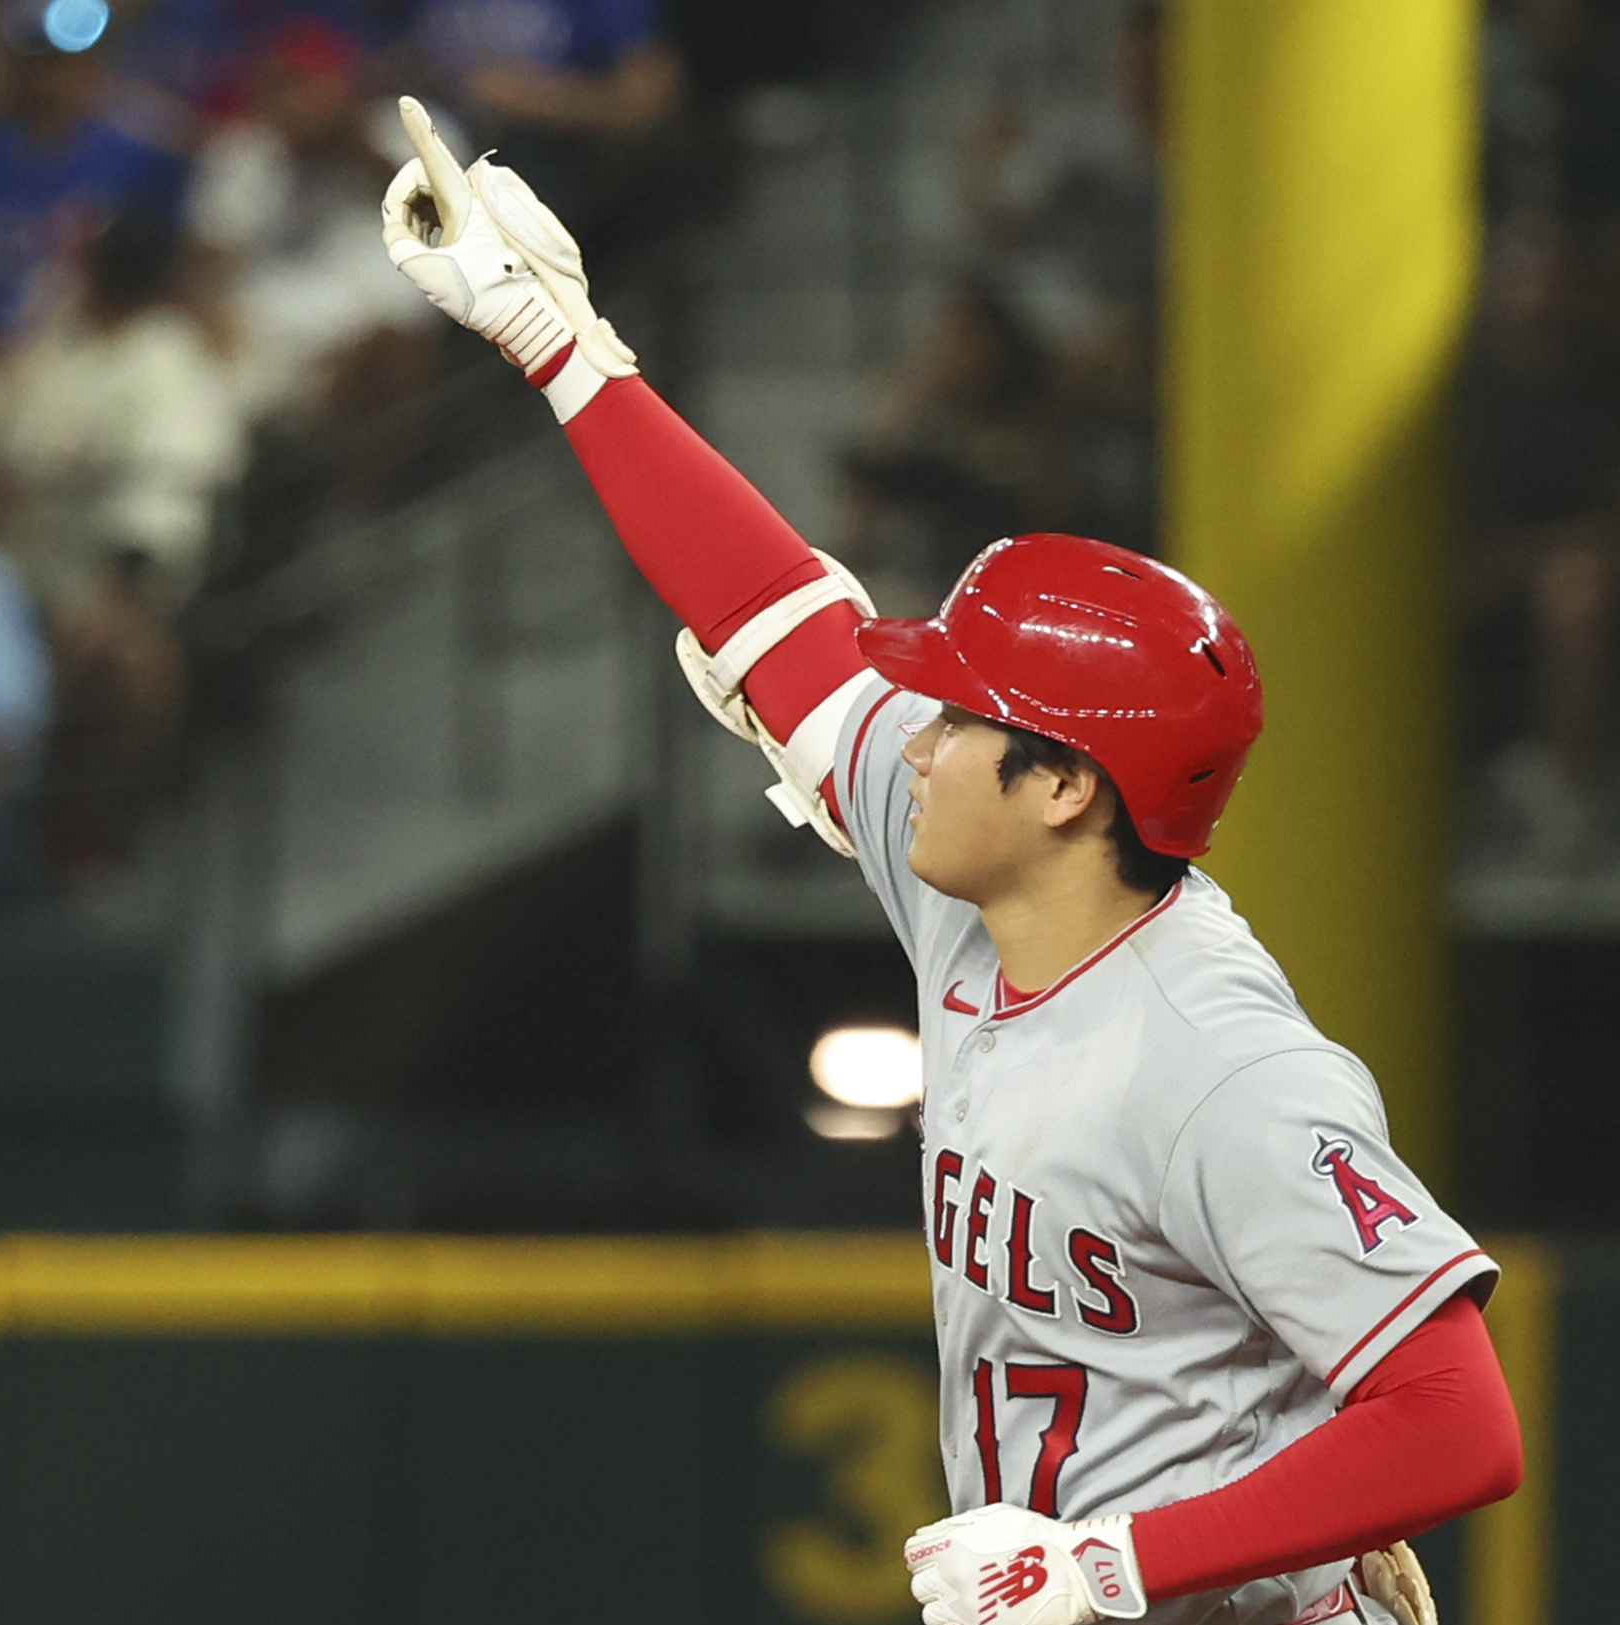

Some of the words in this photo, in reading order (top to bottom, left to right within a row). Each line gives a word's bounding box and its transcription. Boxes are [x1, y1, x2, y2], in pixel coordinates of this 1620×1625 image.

[1310, 1128, 1421, 1258] A
[973, 1356, 1088, 1518] 17
[909, 1539, 952, 1563] balance
